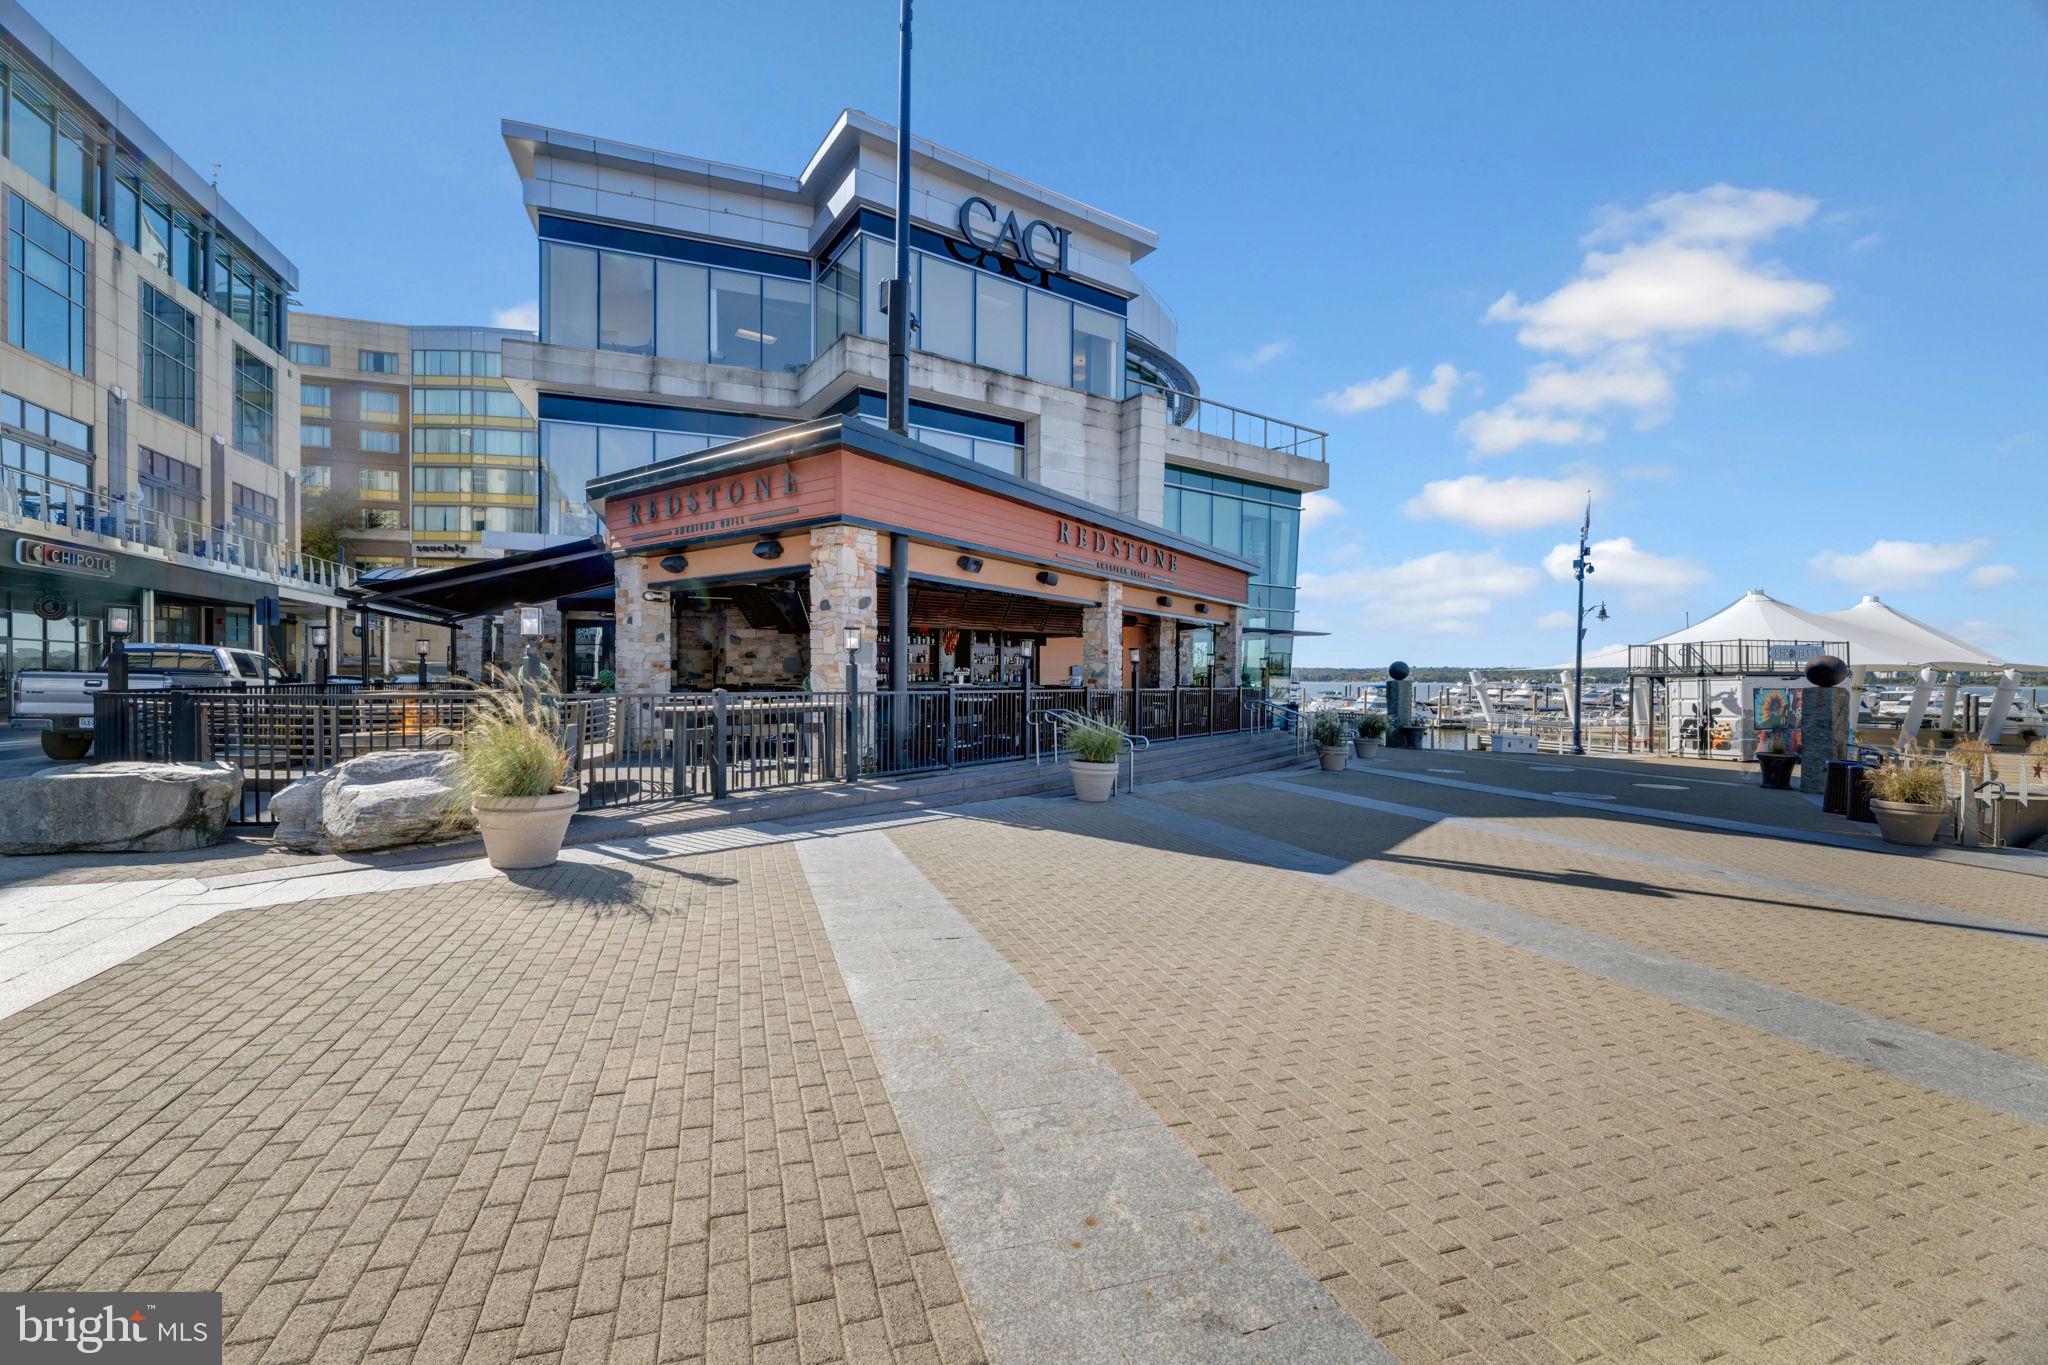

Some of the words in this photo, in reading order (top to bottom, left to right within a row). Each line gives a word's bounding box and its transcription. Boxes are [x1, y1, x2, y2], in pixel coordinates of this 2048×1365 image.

[959, 196, 1072, 273] CACI
[628, 467, 799, 526] REDSTONE
[51, 550, 116, 572] CHIPOTLE
[1057, 519, 1178, 573] REDSTONE
